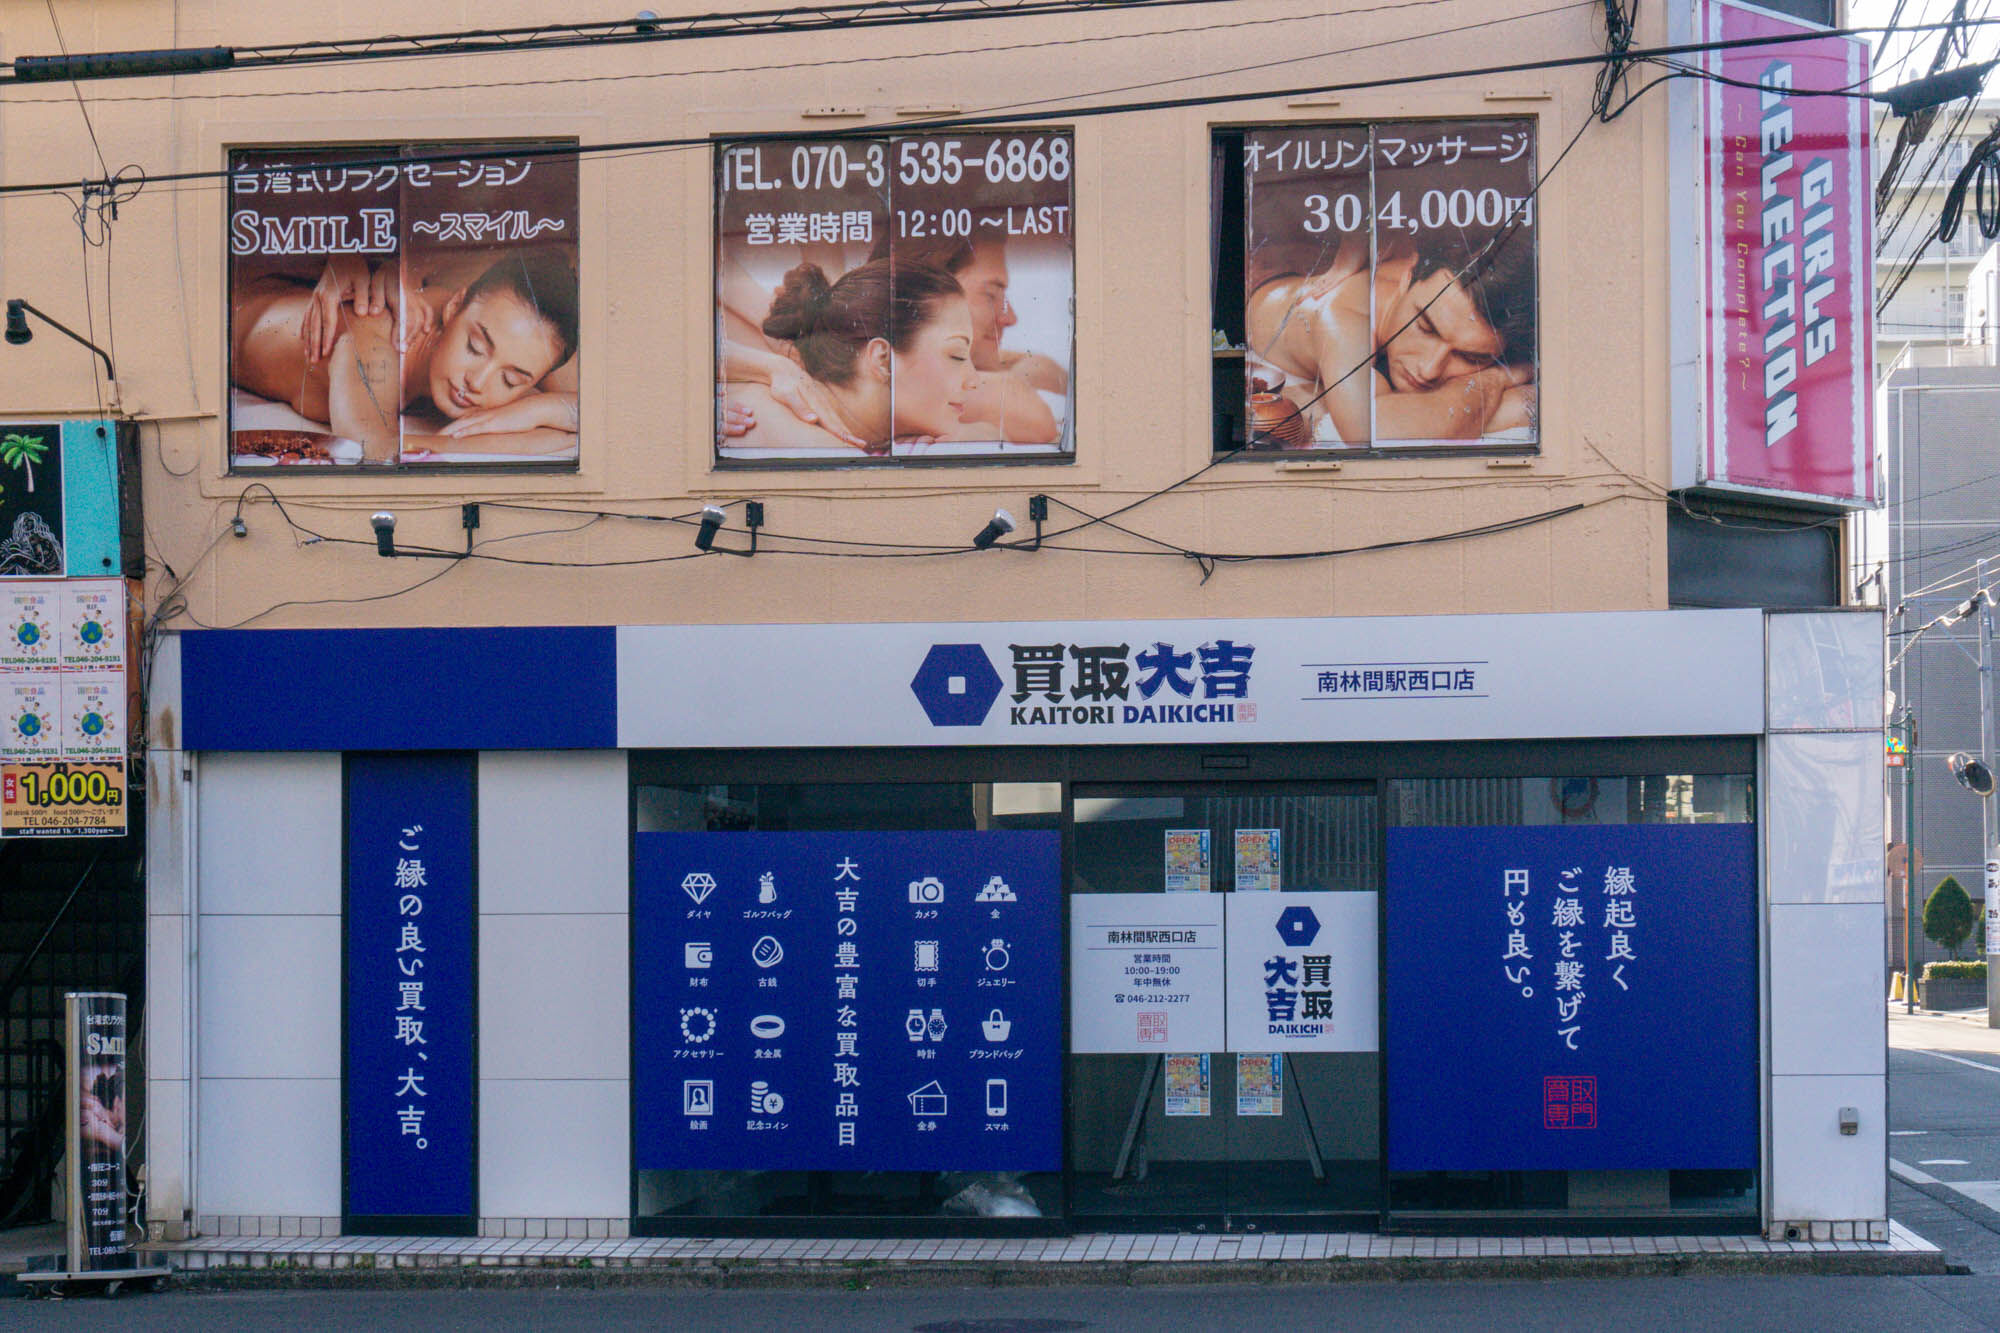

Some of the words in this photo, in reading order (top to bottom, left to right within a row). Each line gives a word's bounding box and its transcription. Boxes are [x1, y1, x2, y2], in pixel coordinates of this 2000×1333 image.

[231, 208, 397, 255] SMILE
[745, 210, 873, 245] 営業時間
[897, 208, 972, 238] 12:00
[1760, 60, 1797, 448] SELECTION
[1802, 157, 1836, 368] GIRLS
[1008, 640, 1255, 704] 買取大吉
[1317, 668, 1475, 693] 南林間駅西口店
[1010, 705, 1115, 725] KAITORI
[1122, 703, 1235, 725] DAIKICHI
[21, 771, 121, 806] 1,000円
[23, 817, 40, 826] TEL
[41, 816, 106, 826] 046-204-7784
[686, 910, 712, 919] ダイヤ
[743, 909, 793, 919] ゴルフバッグ
[915, 910, 938, 919] カメラ
[990, 908, 1000, 919] 金
[1502, 869, 1534, 998] 円も良い。
[1603, 866, 1637, 992] 縁起良く
[1107, 930, 1197, 944] 南林間駅西口店
[1133, 953, 1171, 963] 営業時間
[1552, 866, 1586, 1050] ご縁を繋げて
[394, 824, 429, 1150] ご縁の良い買取、大吉。
[917, 977, 937, 988] 切手
[977, 977, 1017, 988] ジュエリー
[1133, 977, 1172, 987] 年中無休
[1263, 955, 1299, 1021] 大吉
[1300, 954, 1333, 1020] 買取
[834, 856, 861, 1146] 大吉の豊富な買取品目
[1127, 994, 1191, 1003] 046-212-2277
[1268, 1024, 1324, 1034] DAIKICHI
[673, 1049, 725, 1059] アクセサリー
[916, 1049, 937, 1060] 時計
[969, 1049, 1024, 1060] ブランドバッグ
[746, 1120, 789, 1131] 記念コイン
[984, 1122, 1009, 1132] スマホ
